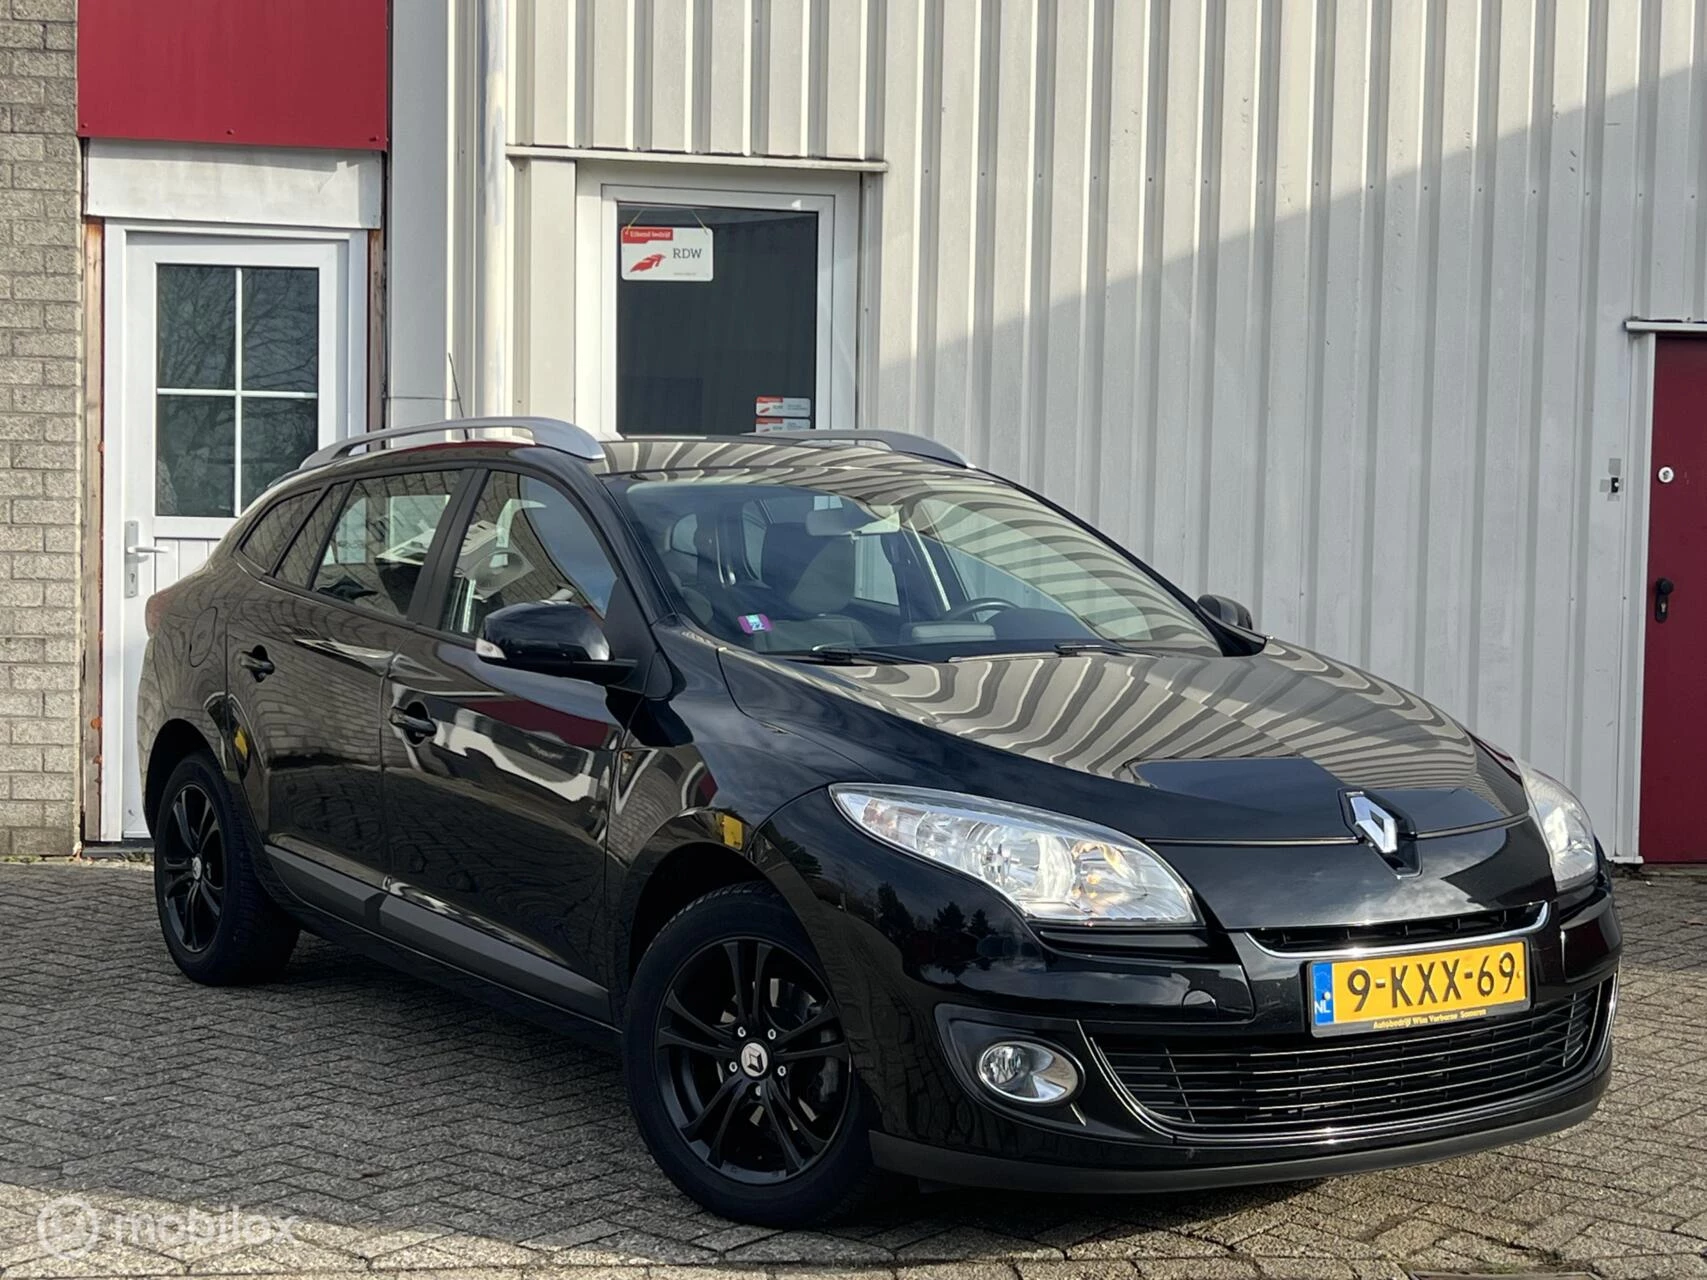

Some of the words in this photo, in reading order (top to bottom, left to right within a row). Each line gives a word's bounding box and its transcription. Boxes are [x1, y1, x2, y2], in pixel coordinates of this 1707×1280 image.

[672, 248, 702, 259] RDW
[1347, 951, 1516, 1013] 9-KXX-69
[1314, 999, 1331, 1014] NL
